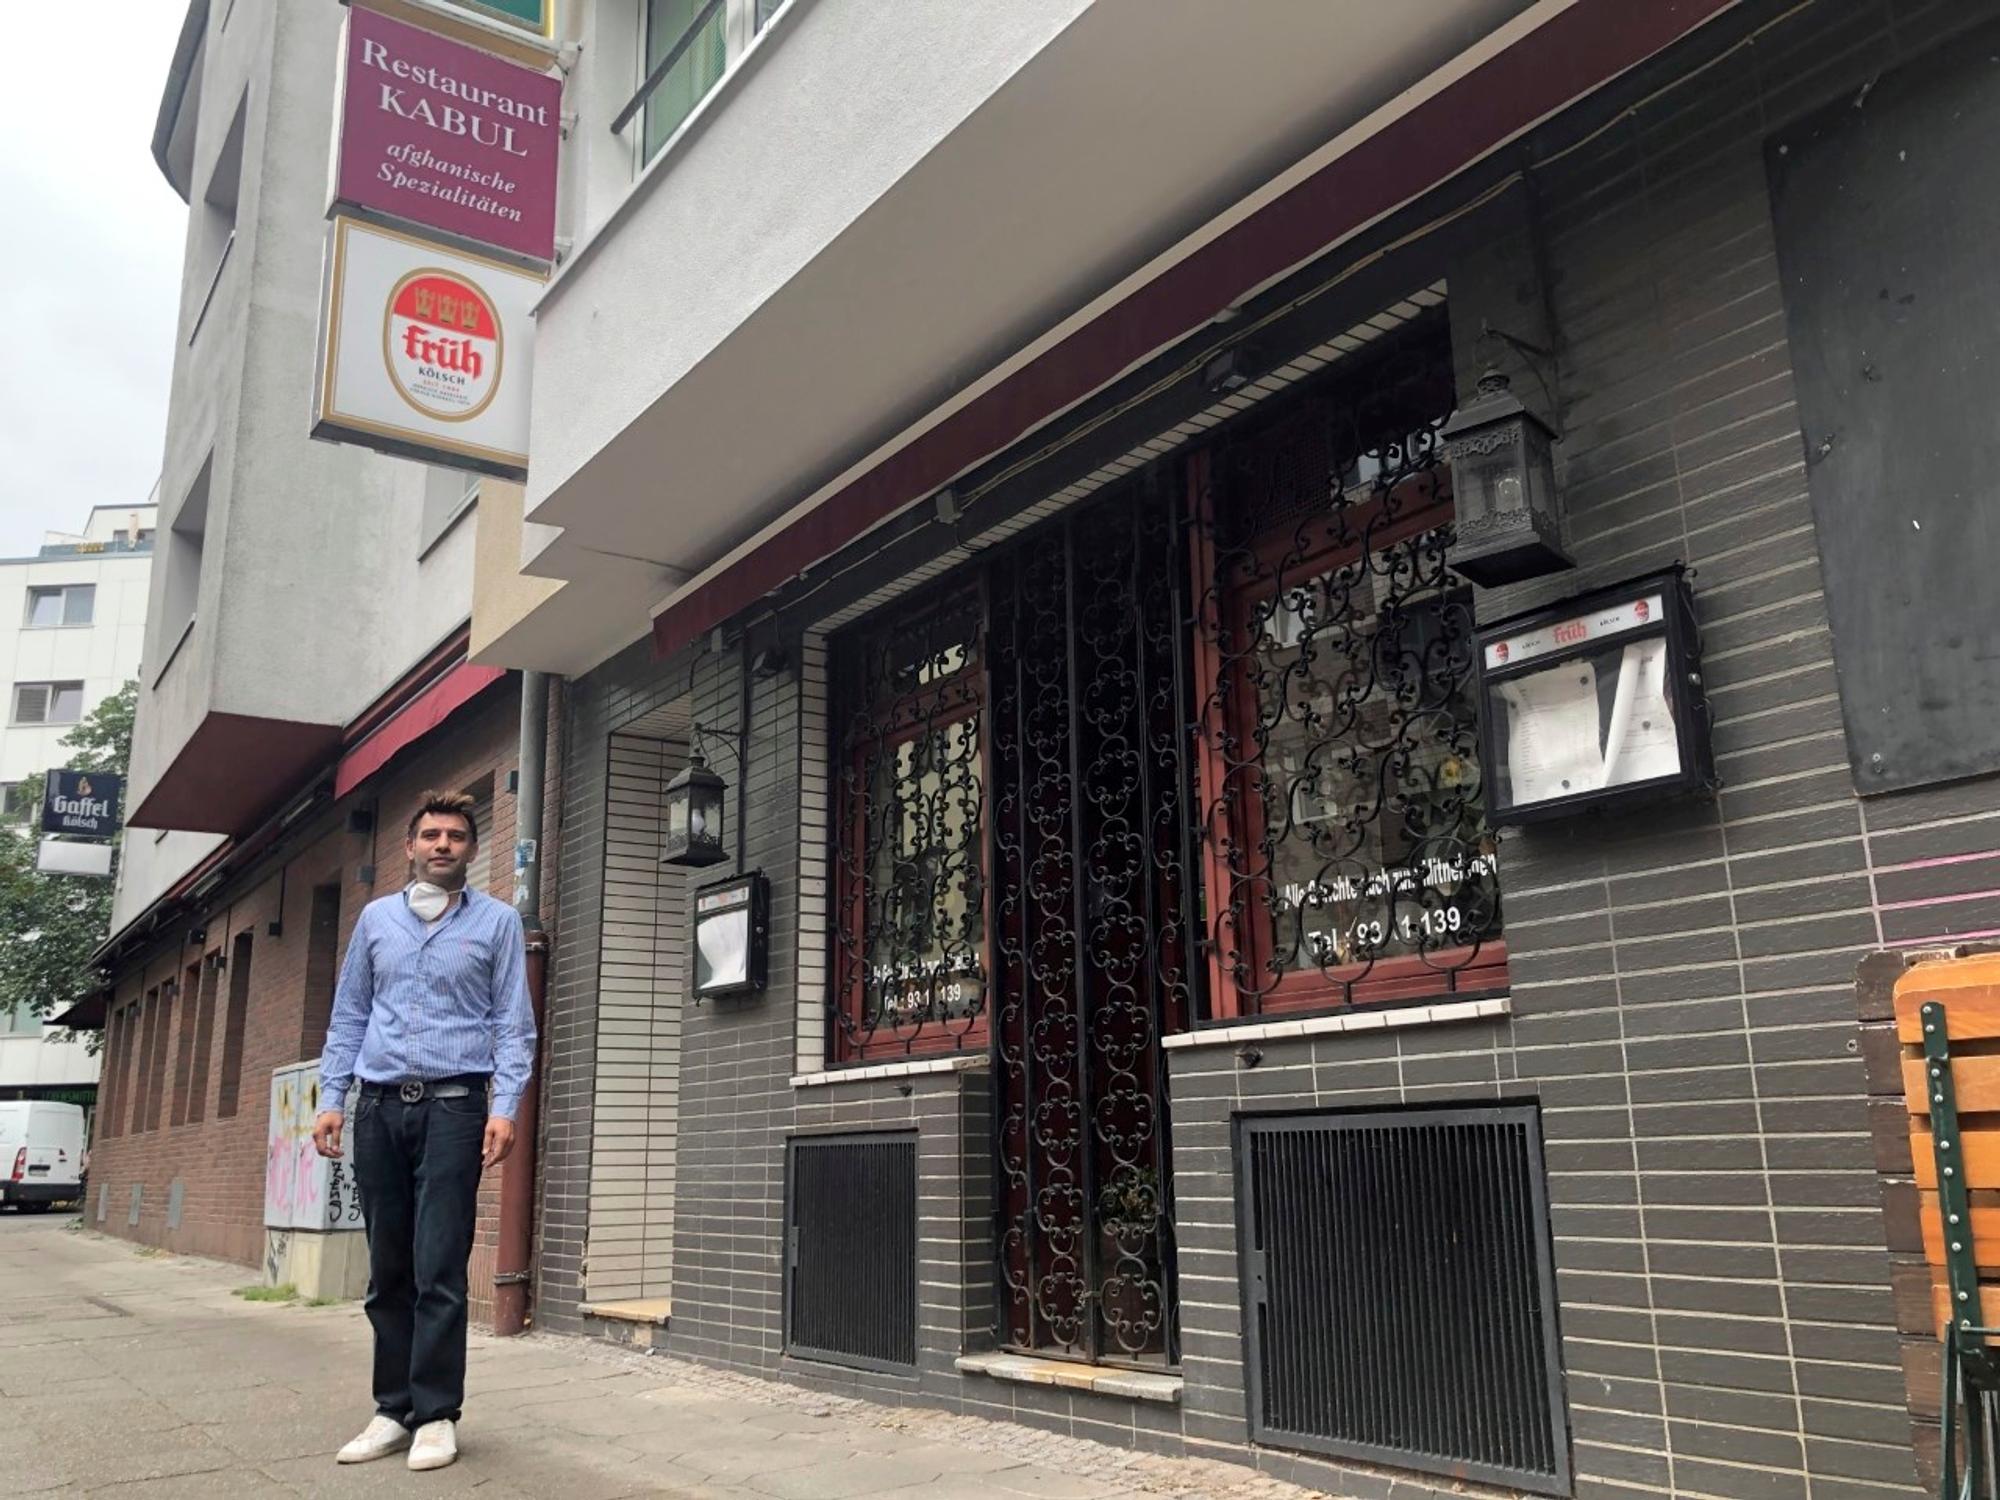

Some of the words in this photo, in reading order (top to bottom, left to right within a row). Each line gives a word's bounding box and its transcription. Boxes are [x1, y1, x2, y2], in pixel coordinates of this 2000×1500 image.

[361, 38, 549, 127] Restaurant
[379, 83, 528, 157] KABUL
[387, 142, 516, 194] afghanische
[377, 163, 522, 222] Spezialitäten
[402, 324, 482, 381] Früh
[418, 366, 466, 386] KÖLSCH
[53, 795, 109, 817] Gaffel
[1308, 875, 1357, 904] Grchte
[1420, 906, 1461, 934] 139
[940, 983, 961, 1002] 139
